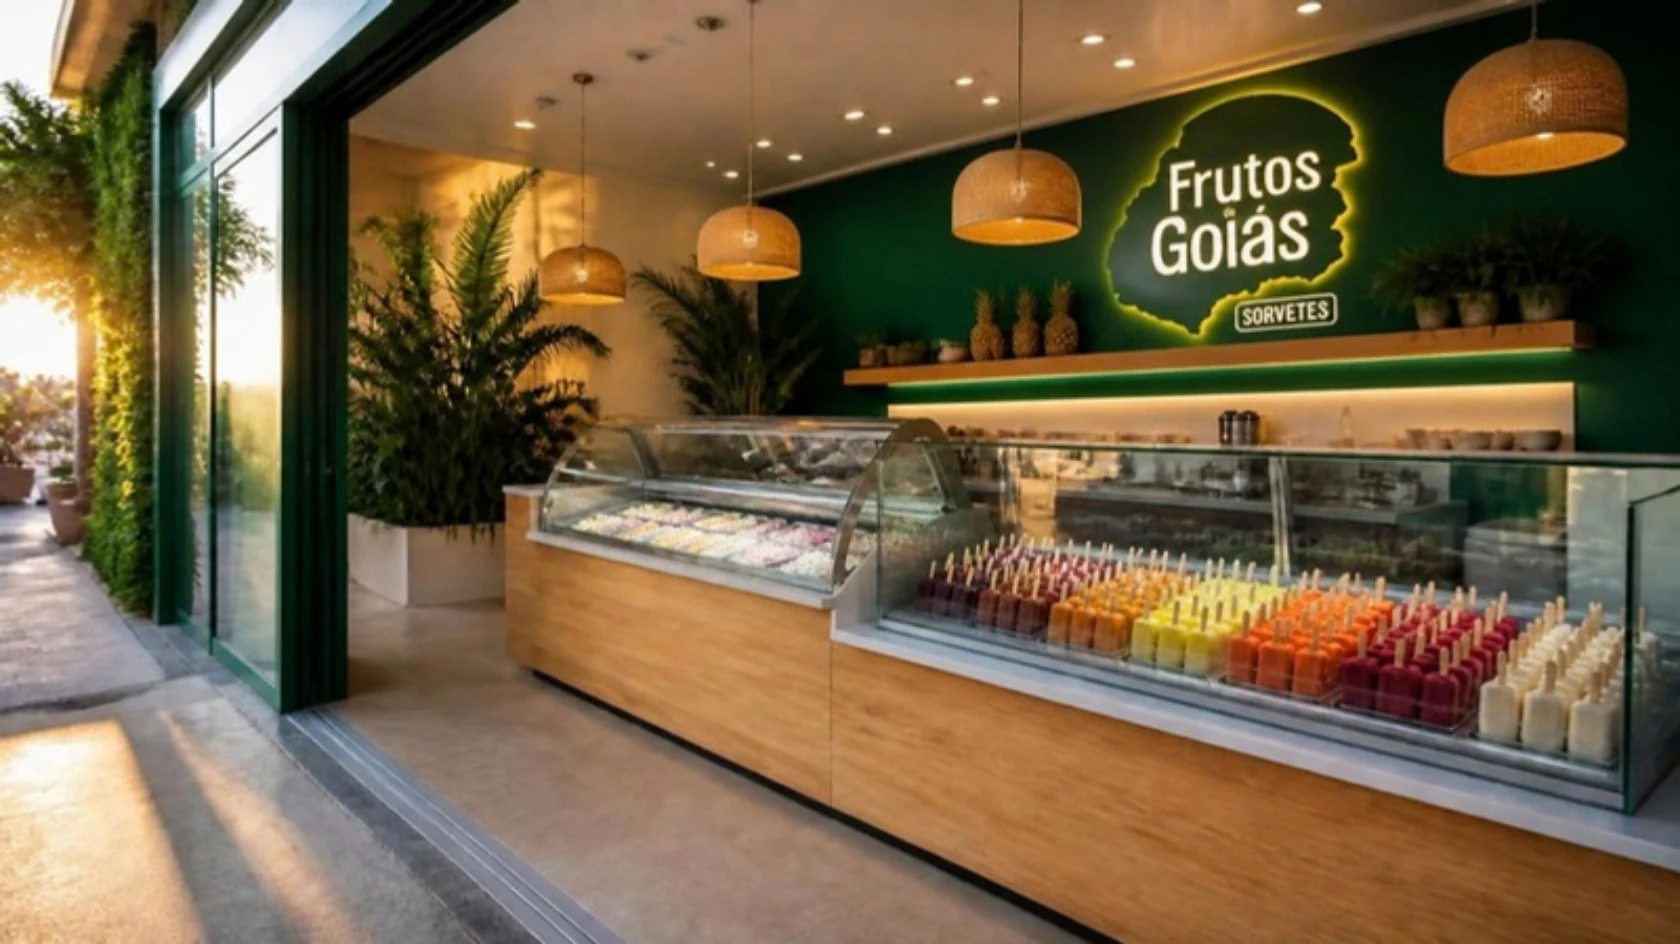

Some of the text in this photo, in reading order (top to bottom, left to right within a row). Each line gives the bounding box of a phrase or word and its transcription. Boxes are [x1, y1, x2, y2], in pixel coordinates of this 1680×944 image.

[1169, 150, 1322, 212] Frutos
[1151, 204, 1310, 276] Goiás
[1242, 300, 1330, 326] SORVETES
